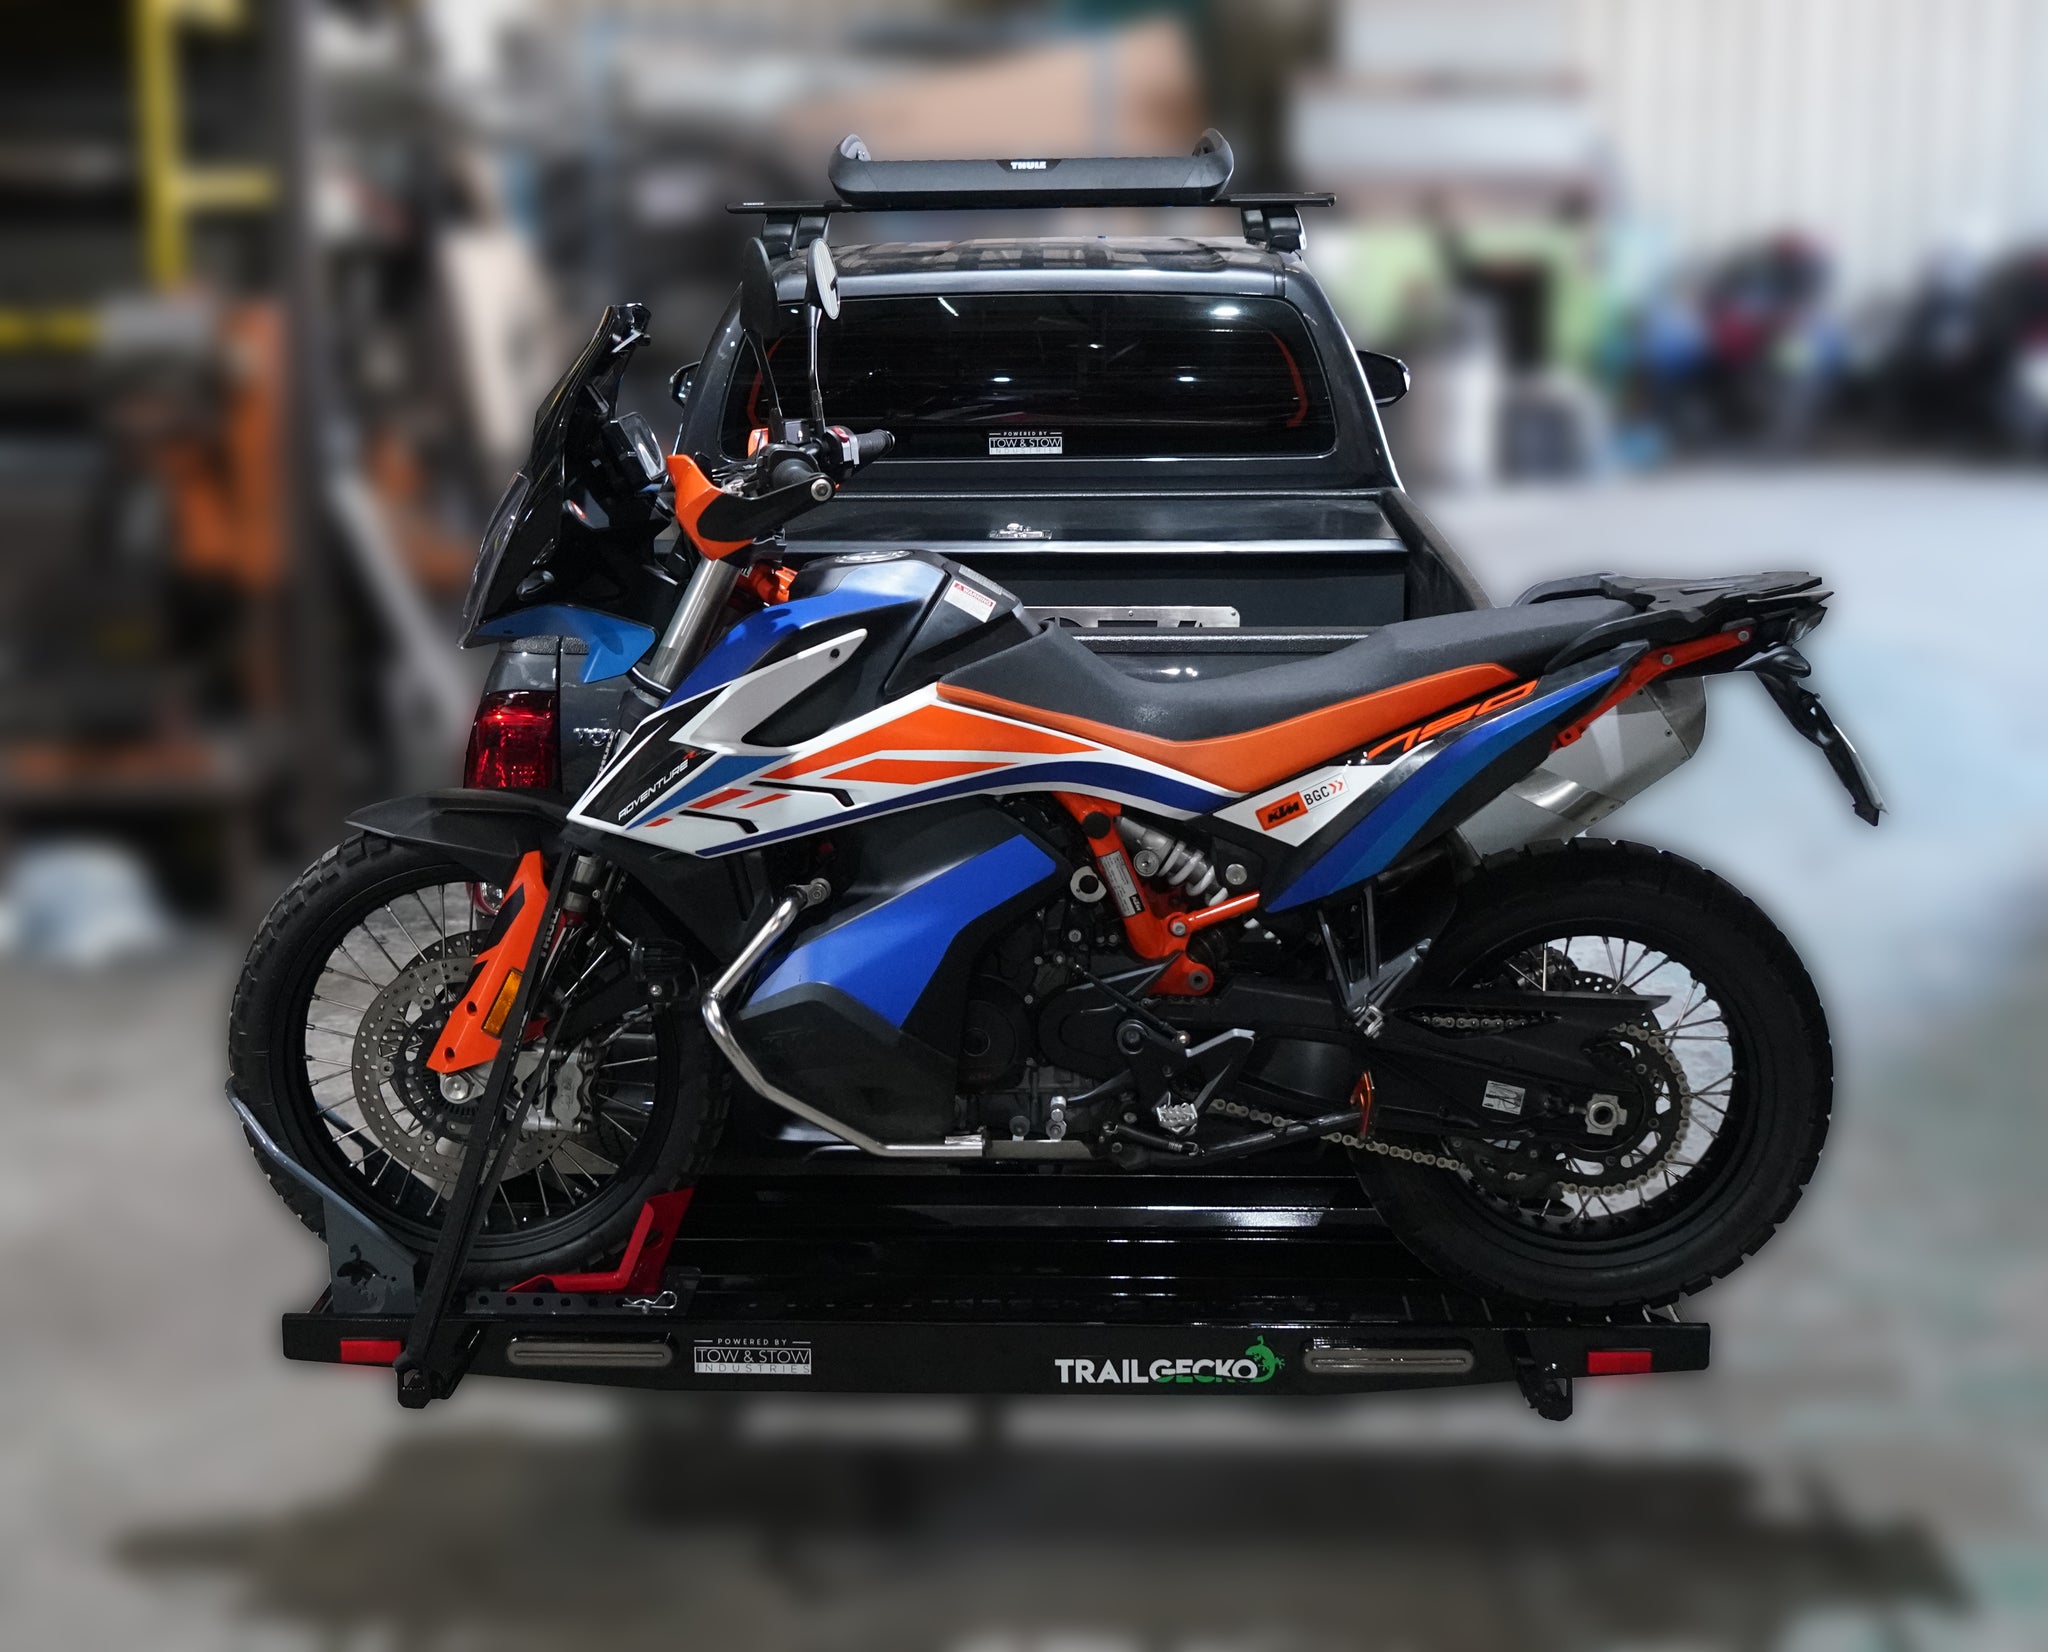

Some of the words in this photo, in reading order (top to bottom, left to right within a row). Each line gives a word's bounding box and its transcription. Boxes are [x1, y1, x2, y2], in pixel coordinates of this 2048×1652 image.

[1010, 161, 1047, 170] THULE
[991, 439, 1017, 448] TOW
[1020, 439, 1026, 448] &
[1029, 438, 1061, 448] STOW
[1367, 680, 1539, 760] 790
[618, 758, 689, 821] ADVENTURE
[1267, 801, 1300, 823] KTM
[1303, 786, 1330, 805] BGC
[717, 1338, 769, 1346] POWERED
[696, 1349, 739, 1363] TOW
[743, 1350, 755, 1363] &
[758, 1349, 810, 1364] STOW
[696, 1363, 810, 1373] INDUSTRIES
